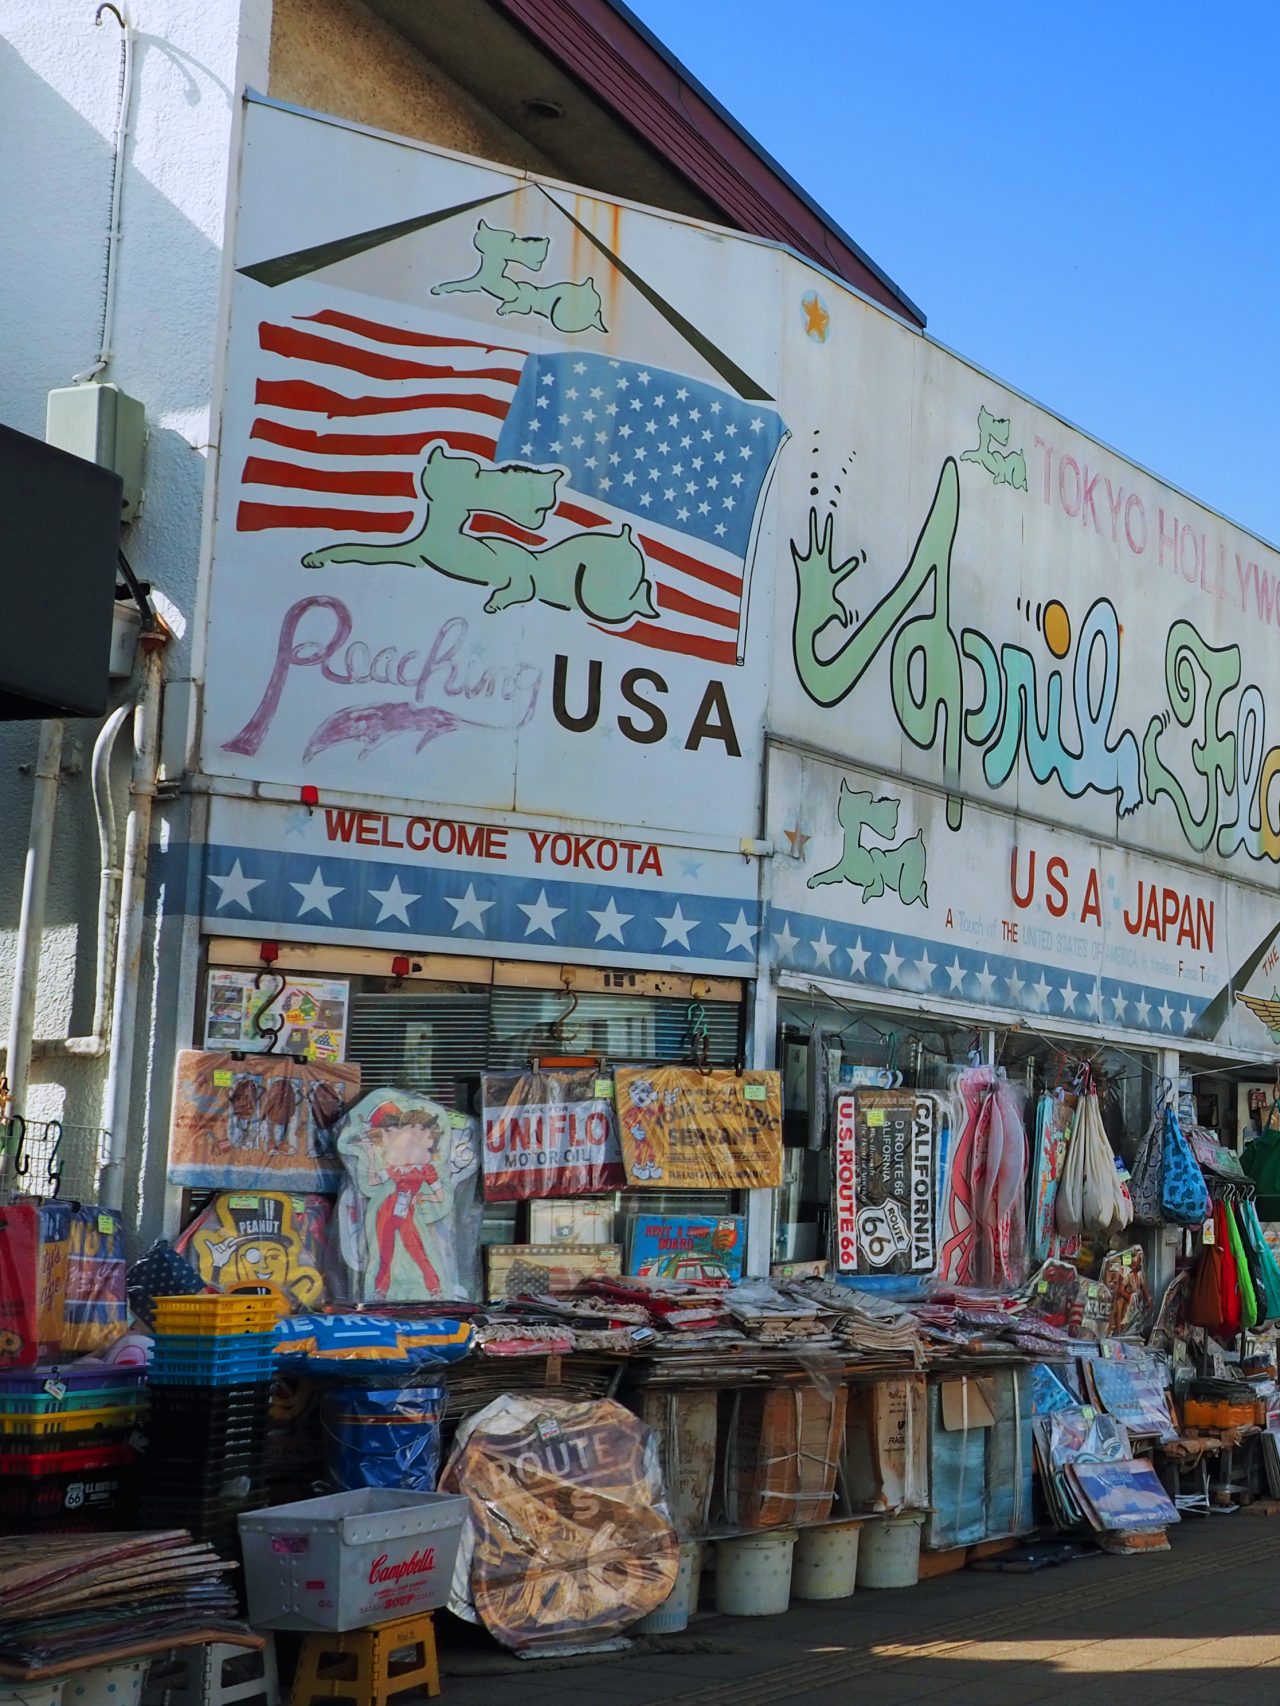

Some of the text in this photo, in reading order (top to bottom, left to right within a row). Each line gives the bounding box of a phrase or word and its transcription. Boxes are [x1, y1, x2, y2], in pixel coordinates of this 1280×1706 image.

[1034, 437, 1146, 555] TOKYO
[552, 652, 743, 758] USA
[325, 808, 665, 878] WELCOME YOKOTA
[945, 907, 954, 929] A
[1002, 920, 1018, 944] THE
[1022, 925, 1052, 951] UNITED
[1056, 932, 1089, 959] STATES
[1124, 879, 1216, 954] JAPAN
[1262, 945, 1280, 977] THE
[486, 1112, 610, 1153] UNIFLO
[894, 1133, 904, 1178] ROUTE
[894, 1180, 904, 1196] 66
[914, 1103, 931, 1263] CALIFORNIA
[239, 1221, 281, 1234] PEANUT
[658, 1238, 694, 1249] BOARD
[862, 1216, 892, 1257] 66
[887, 1207, 905, 1244] ROUTE
[841, 1236, 855, 1265] 66
[68, 1492, 81, 1504] 66
